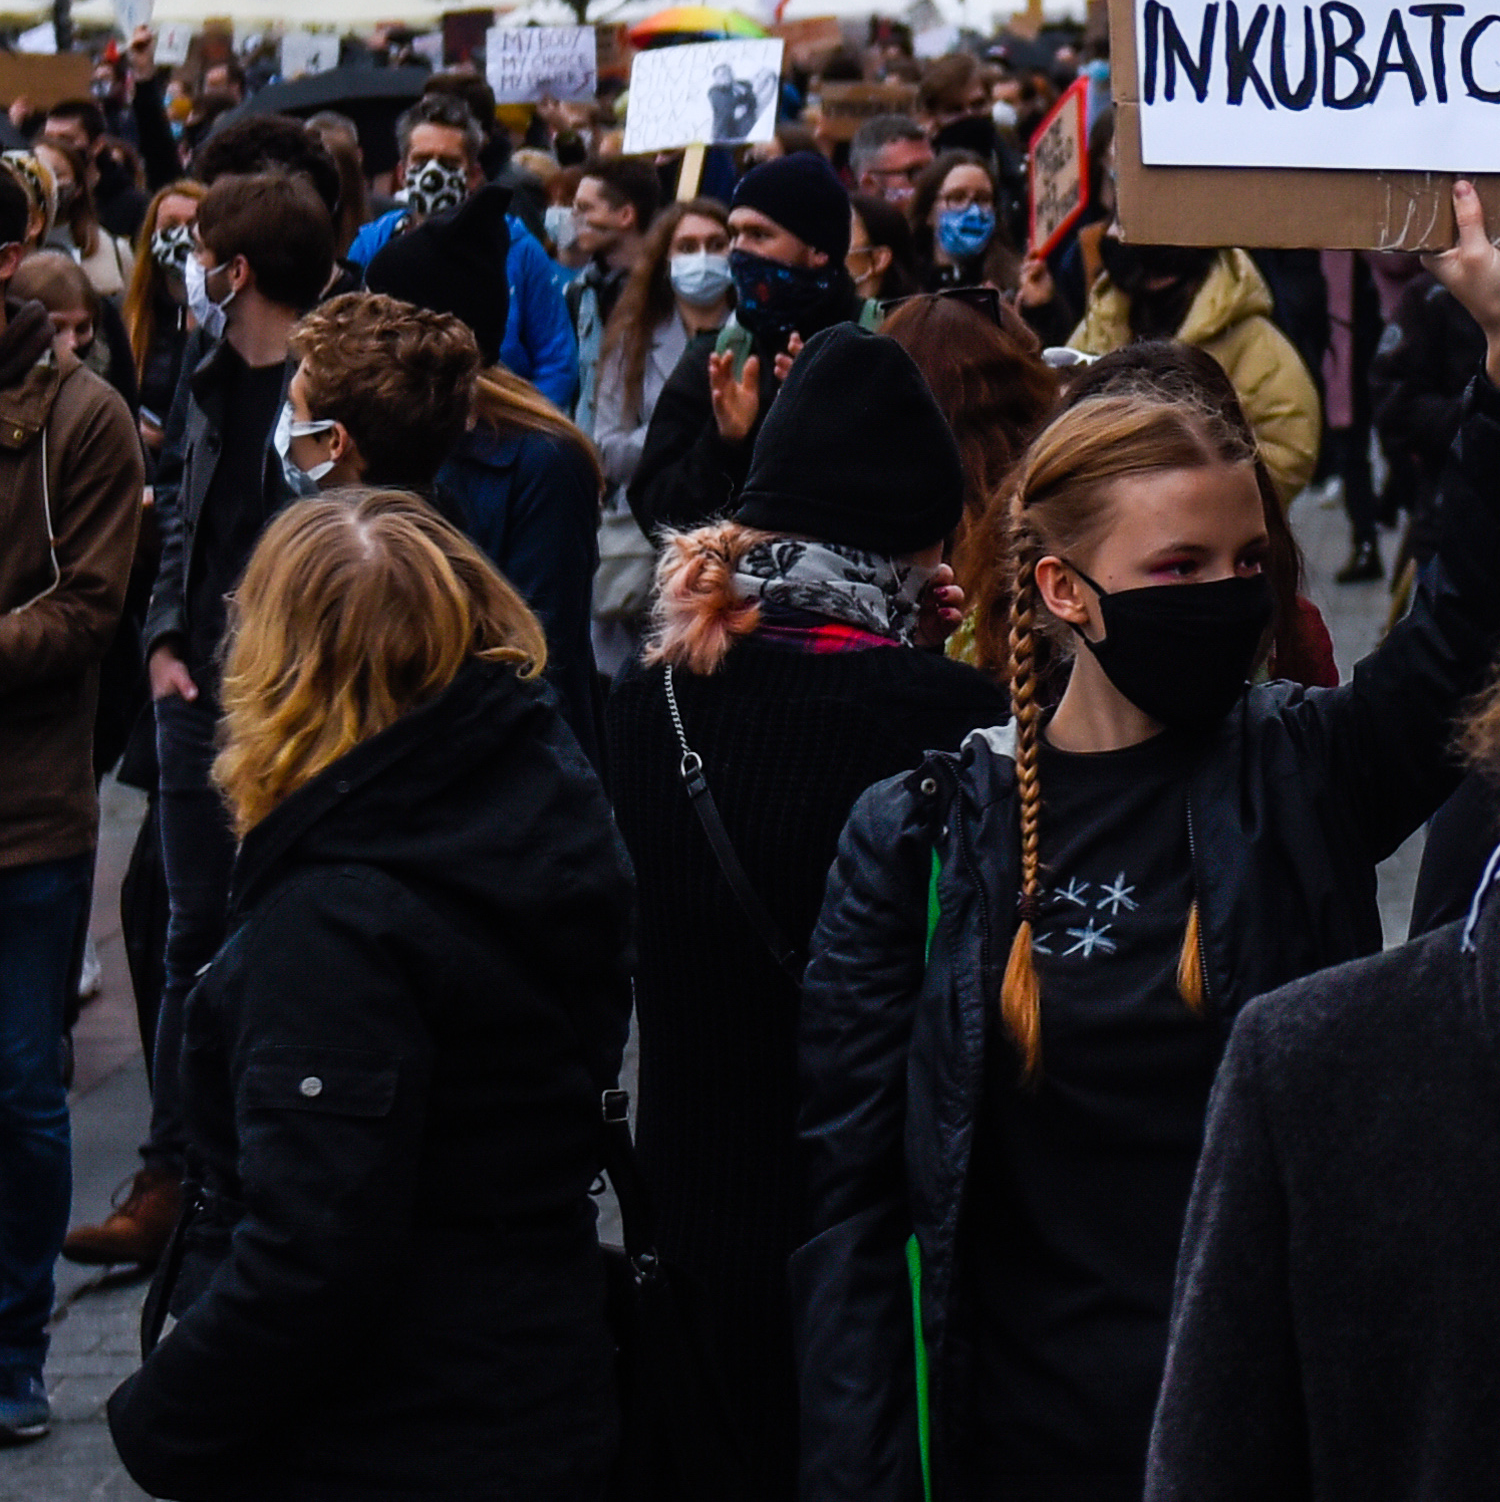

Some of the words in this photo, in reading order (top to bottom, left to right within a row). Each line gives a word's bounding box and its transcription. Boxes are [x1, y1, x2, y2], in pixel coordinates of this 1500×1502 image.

[502, 27, 534, 54] MY
[538, 27, 582, 52] BODY
[501, 55, 526, 75] MY
[629, 106, 687, 130] OWN
